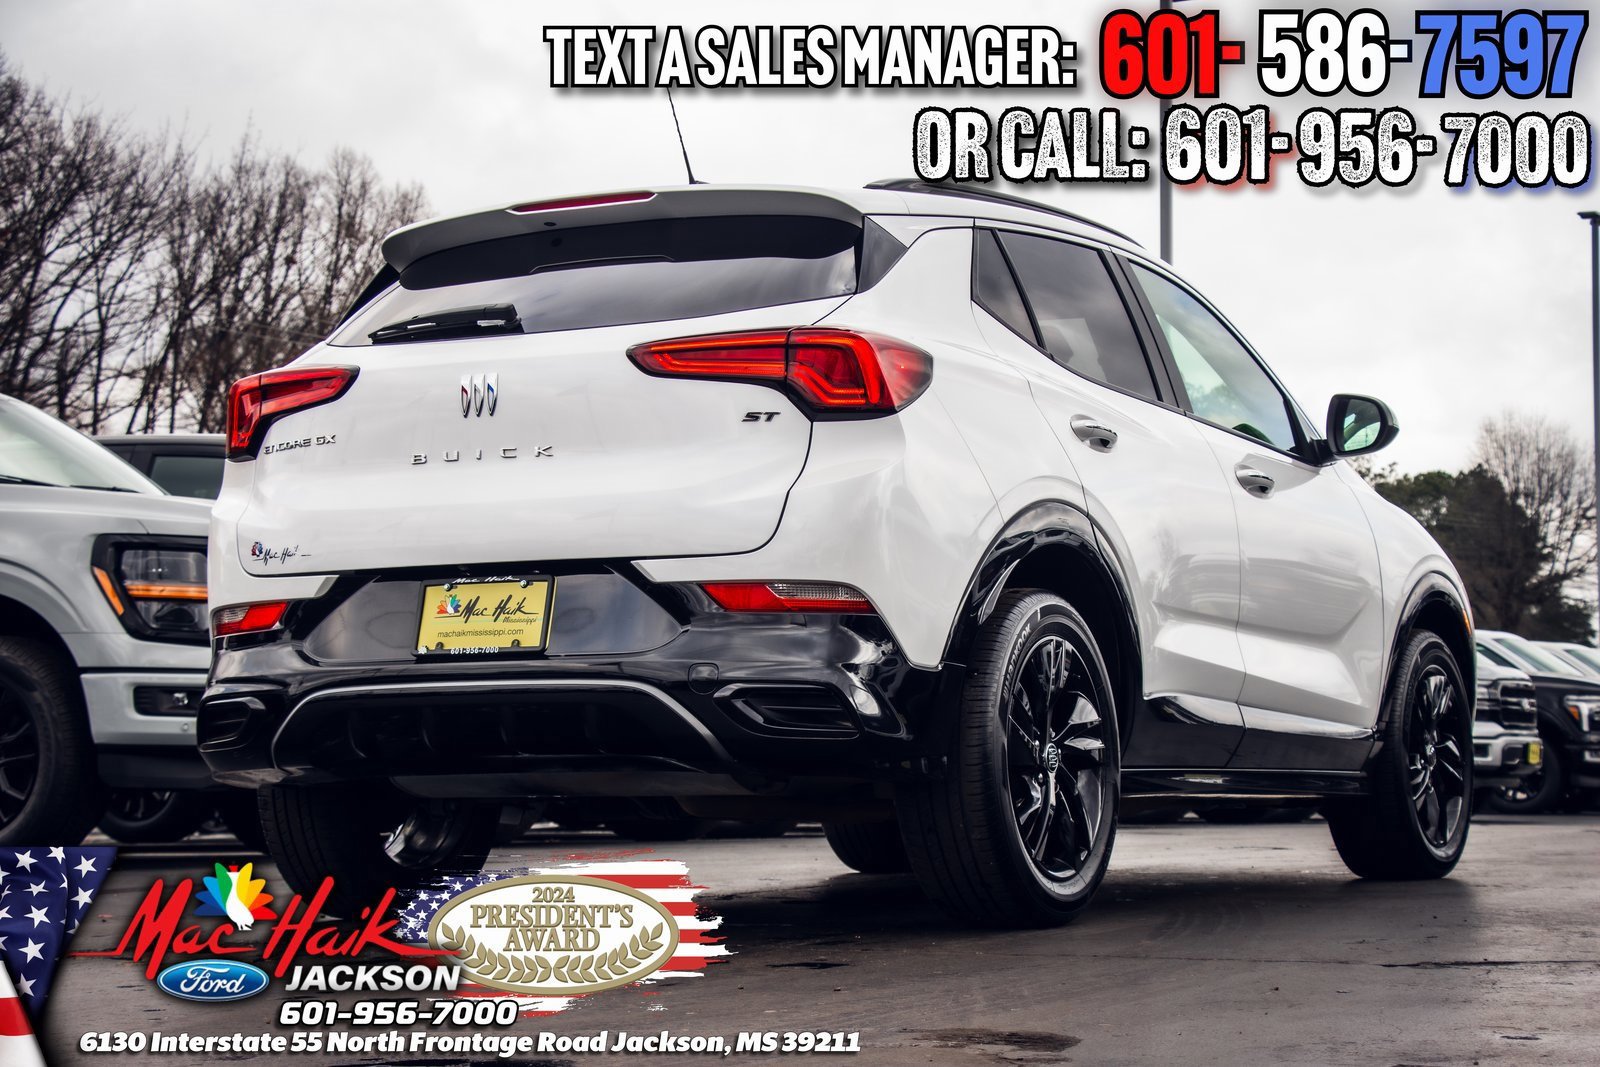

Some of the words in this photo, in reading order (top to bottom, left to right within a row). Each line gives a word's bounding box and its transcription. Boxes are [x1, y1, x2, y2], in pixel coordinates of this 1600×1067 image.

[741, 411, 781, 422] ST
[264, 438, 312, 455] ENCORE
[315, 434, 336, 446] GX
[411, 446, 554, 465] BUICK
[457, 595, 489, 624] Mac
[491, 594, 530, 623] Haik
[437, 627, 524, 639] machaikmississippi.com
